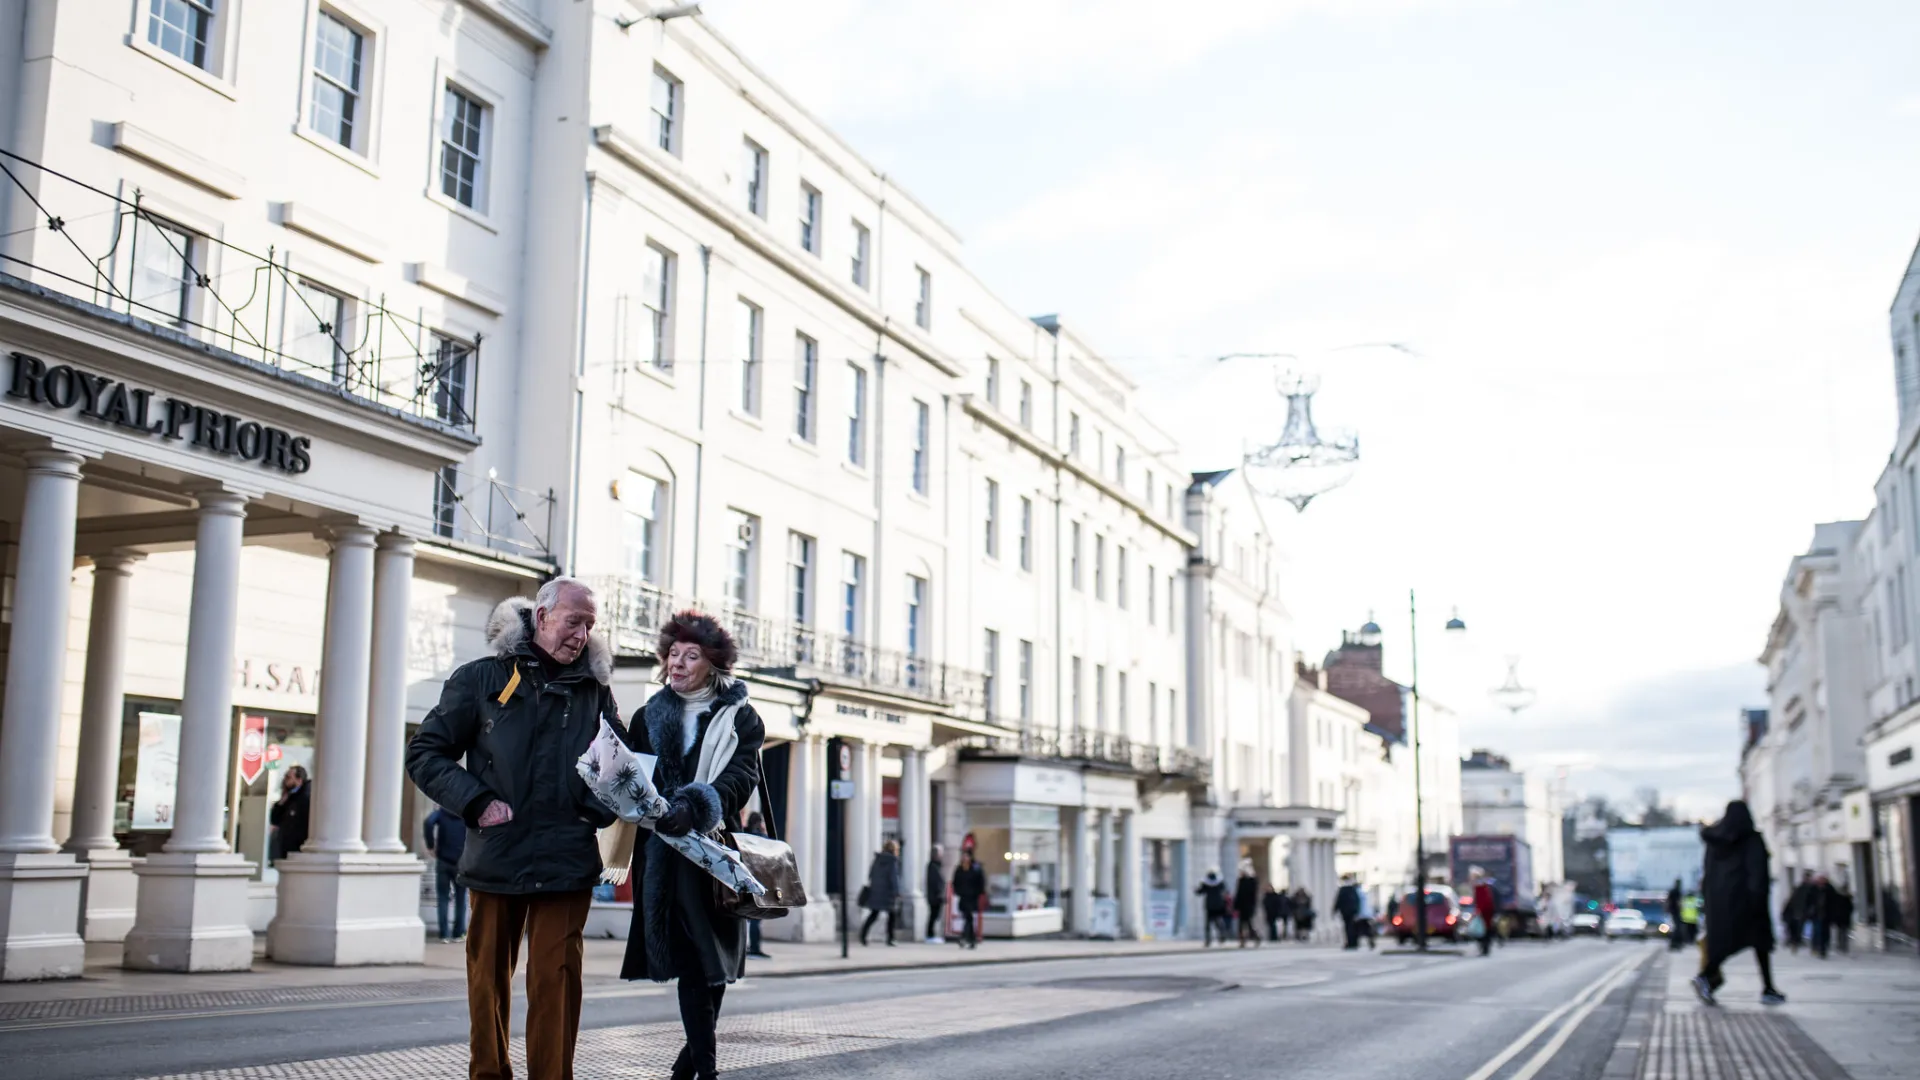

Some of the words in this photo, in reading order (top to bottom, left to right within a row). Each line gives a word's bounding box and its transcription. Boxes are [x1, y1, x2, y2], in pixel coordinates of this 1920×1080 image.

[8, 351, 163, 434] ROYAL
[162, 397, 312, 474] PRIORS
[155, 804, 172, 823] 50
